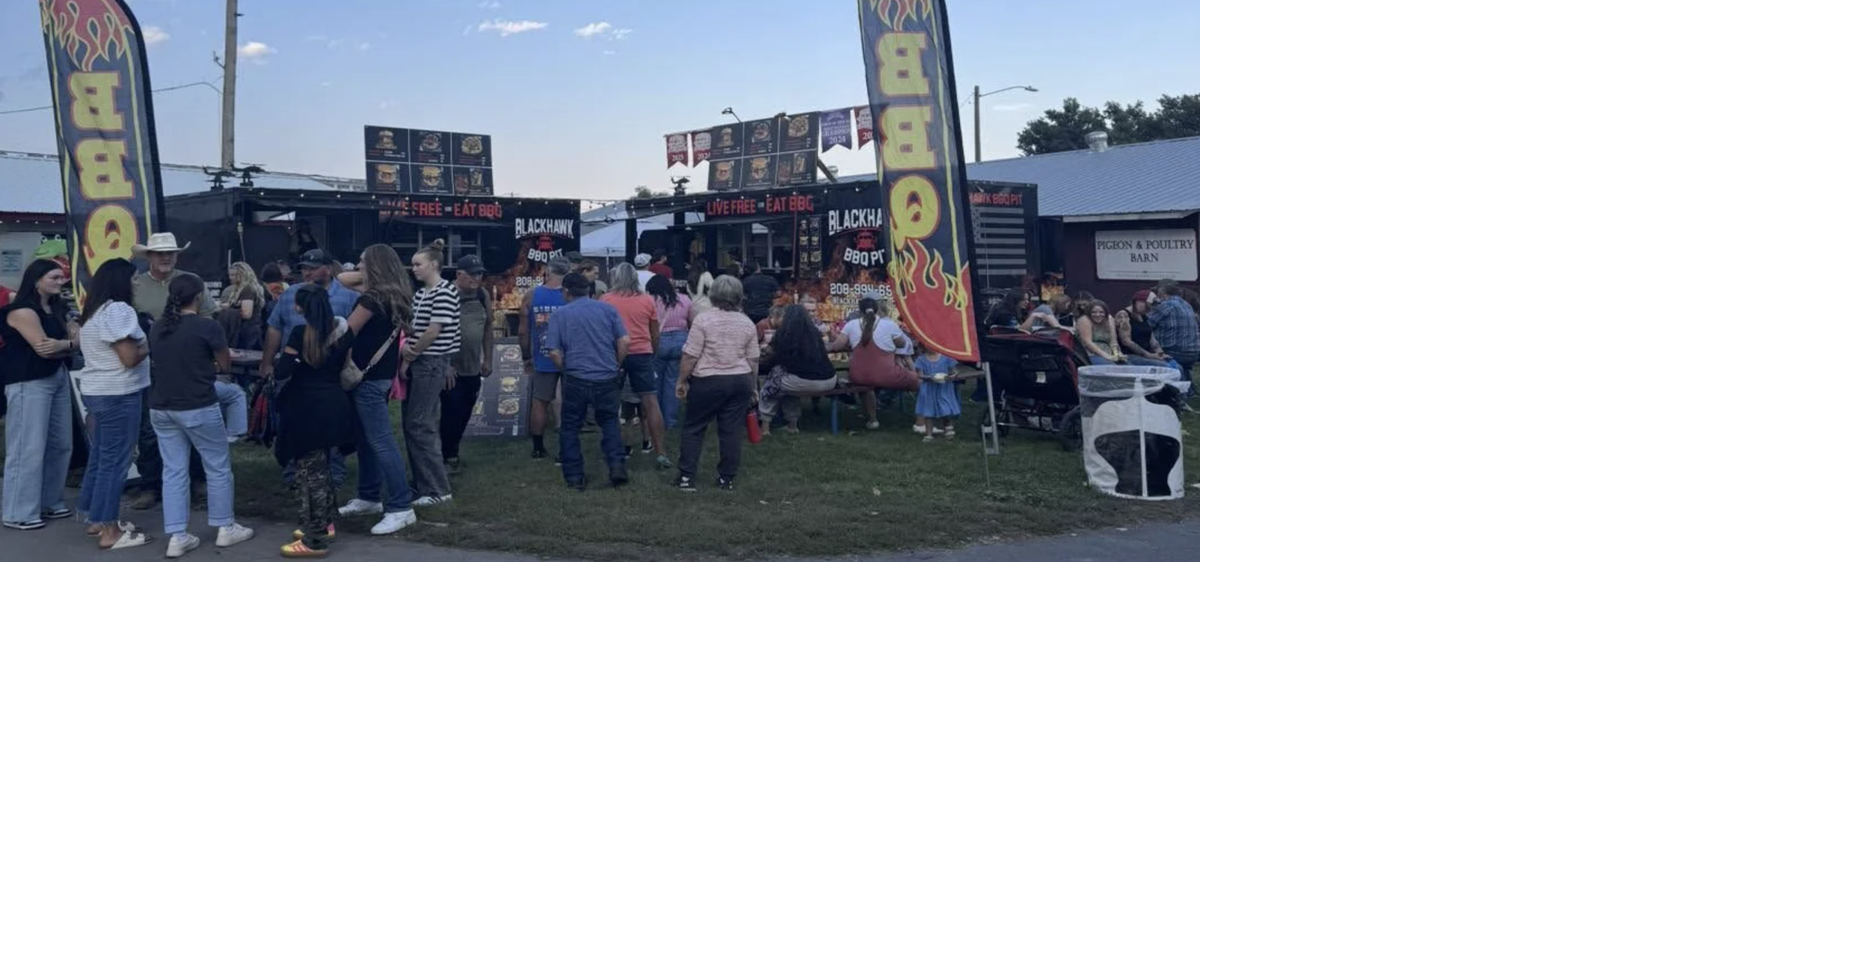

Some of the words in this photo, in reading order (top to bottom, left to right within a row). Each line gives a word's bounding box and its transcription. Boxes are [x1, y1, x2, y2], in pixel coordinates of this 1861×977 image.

[828, 135, 846, 144] 2024
[707, 201, 729, 215] LIVE
[731, 199, 756, 214] FREE
[766, 197, 786, 212] EAT
[1011, 193, 1022, 205] PIT
[411, 202, 442, 216] FREE
[454, 203, 476, 216] EAT
[515, 218, 574, 239] BLACKHAWK
[828, 208, 882, 236] BLACKHA
[1097, 240, 1132, 250] PIGEON
[1136, 240, 1143, 249] &
[1146, 240, 1194, 250] POULTRY
[528, 248, 547, 263] BBQ
[843, 247, 868, 266] BBQ
[1130, 253, 1158, 262] BARN
[830, 282, 893, 297] 208-994-65
